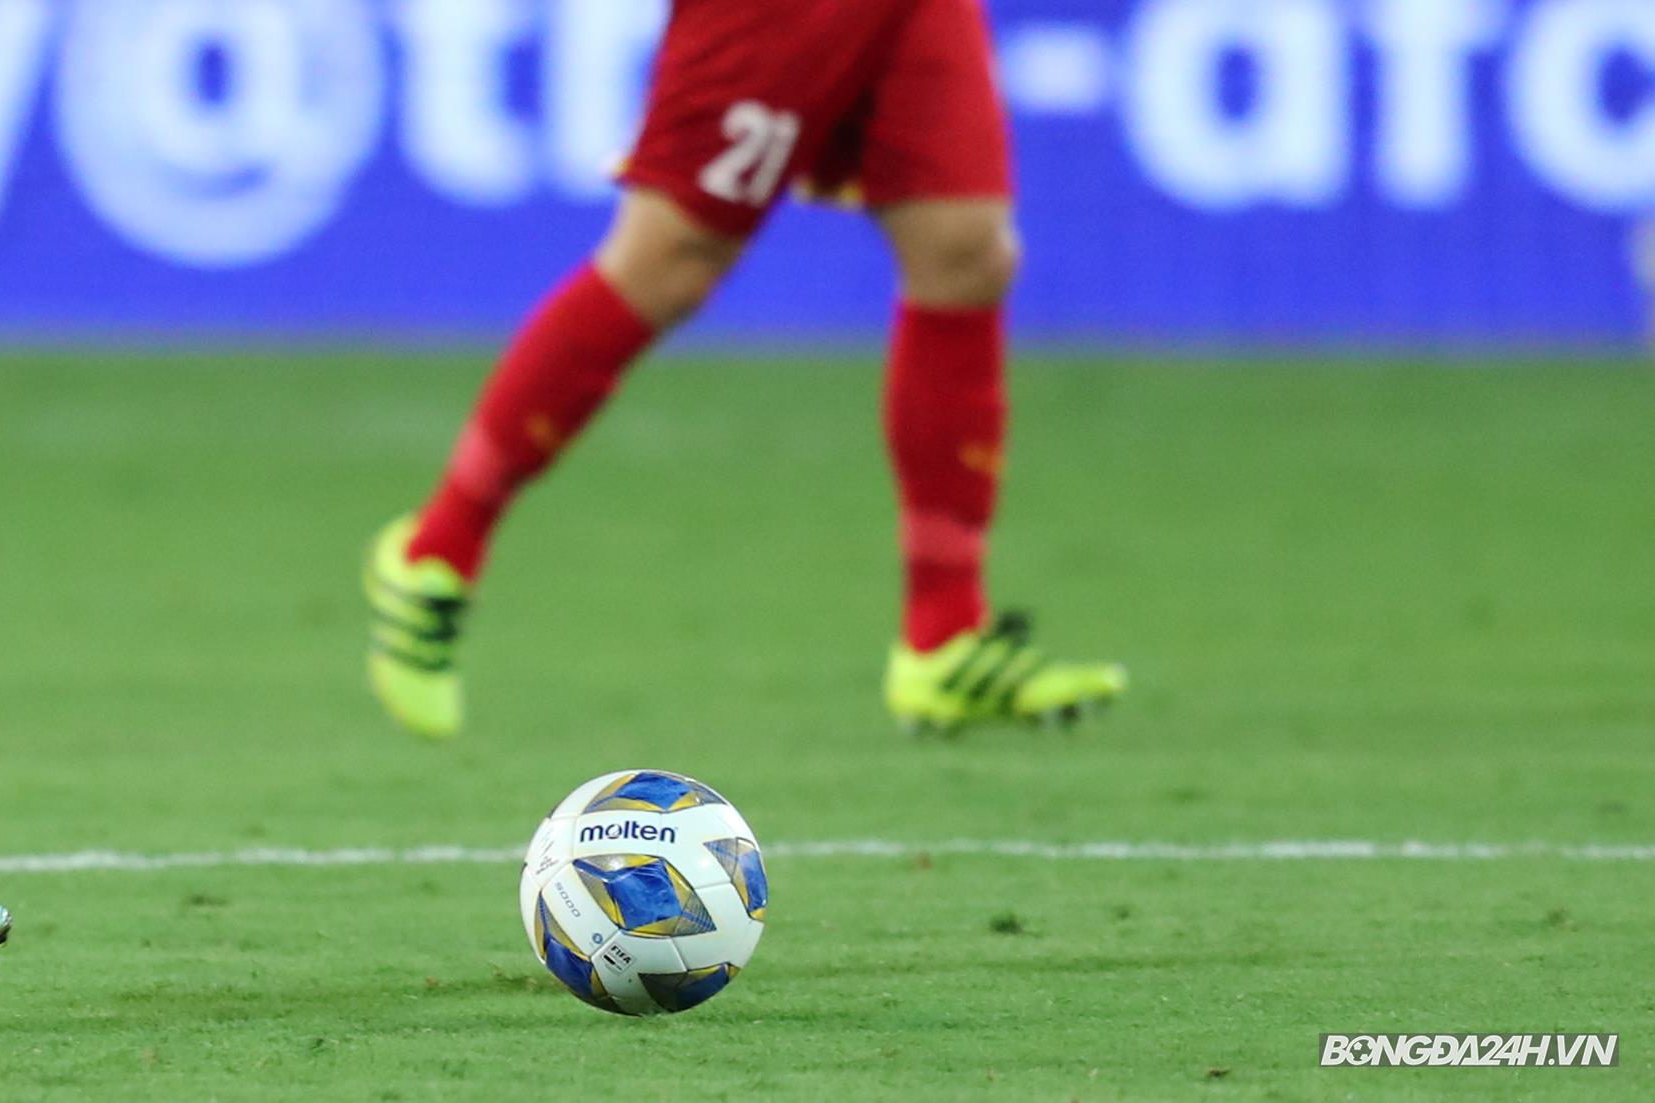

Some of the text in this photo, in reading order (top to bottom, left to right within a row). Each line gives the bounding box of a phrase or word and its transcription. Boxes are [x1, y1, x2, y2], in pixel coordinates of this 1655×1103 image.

[697, 100, 800, 207] 21
[579, 821, 676, 843] molten
[610, 945, 632, 965] FIFA
